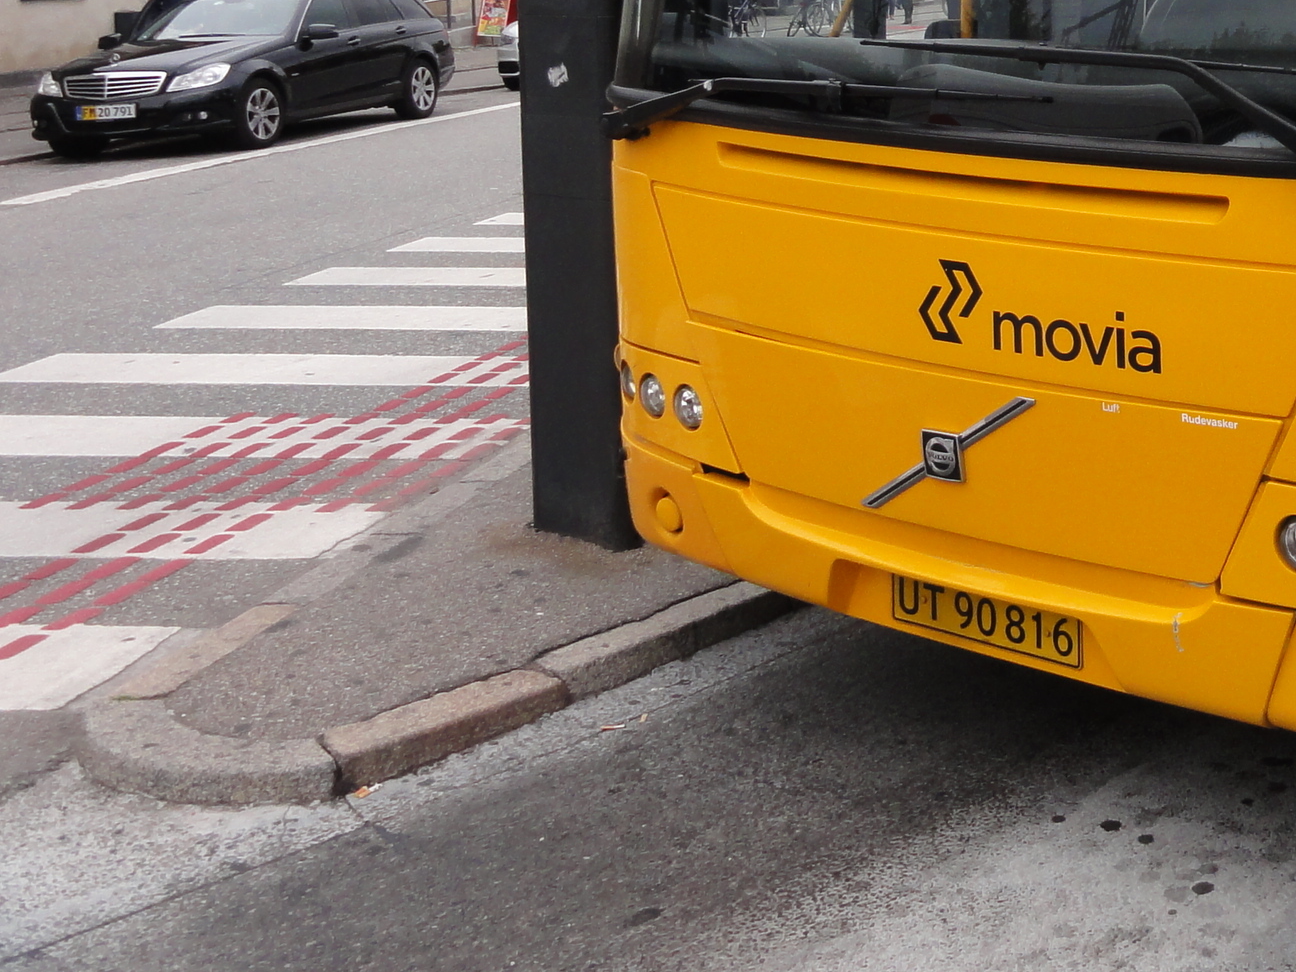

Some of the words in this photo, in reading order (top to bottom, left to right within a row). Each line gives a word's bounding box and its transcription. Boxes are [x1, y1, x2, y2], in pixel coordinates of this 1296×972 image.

[98, 107, 111, 117] 20
[113, 106, 133, 117] 791
[992, 311, 1162, 374] movia
[1102, 402, 1121, 414] Luft
[1181, 413, 1239, 430] Rudevasker
[900, 576, 945, 621] UT
[954, 591, 997, 637] 90
[1005, 605, 1073, 657] 816
